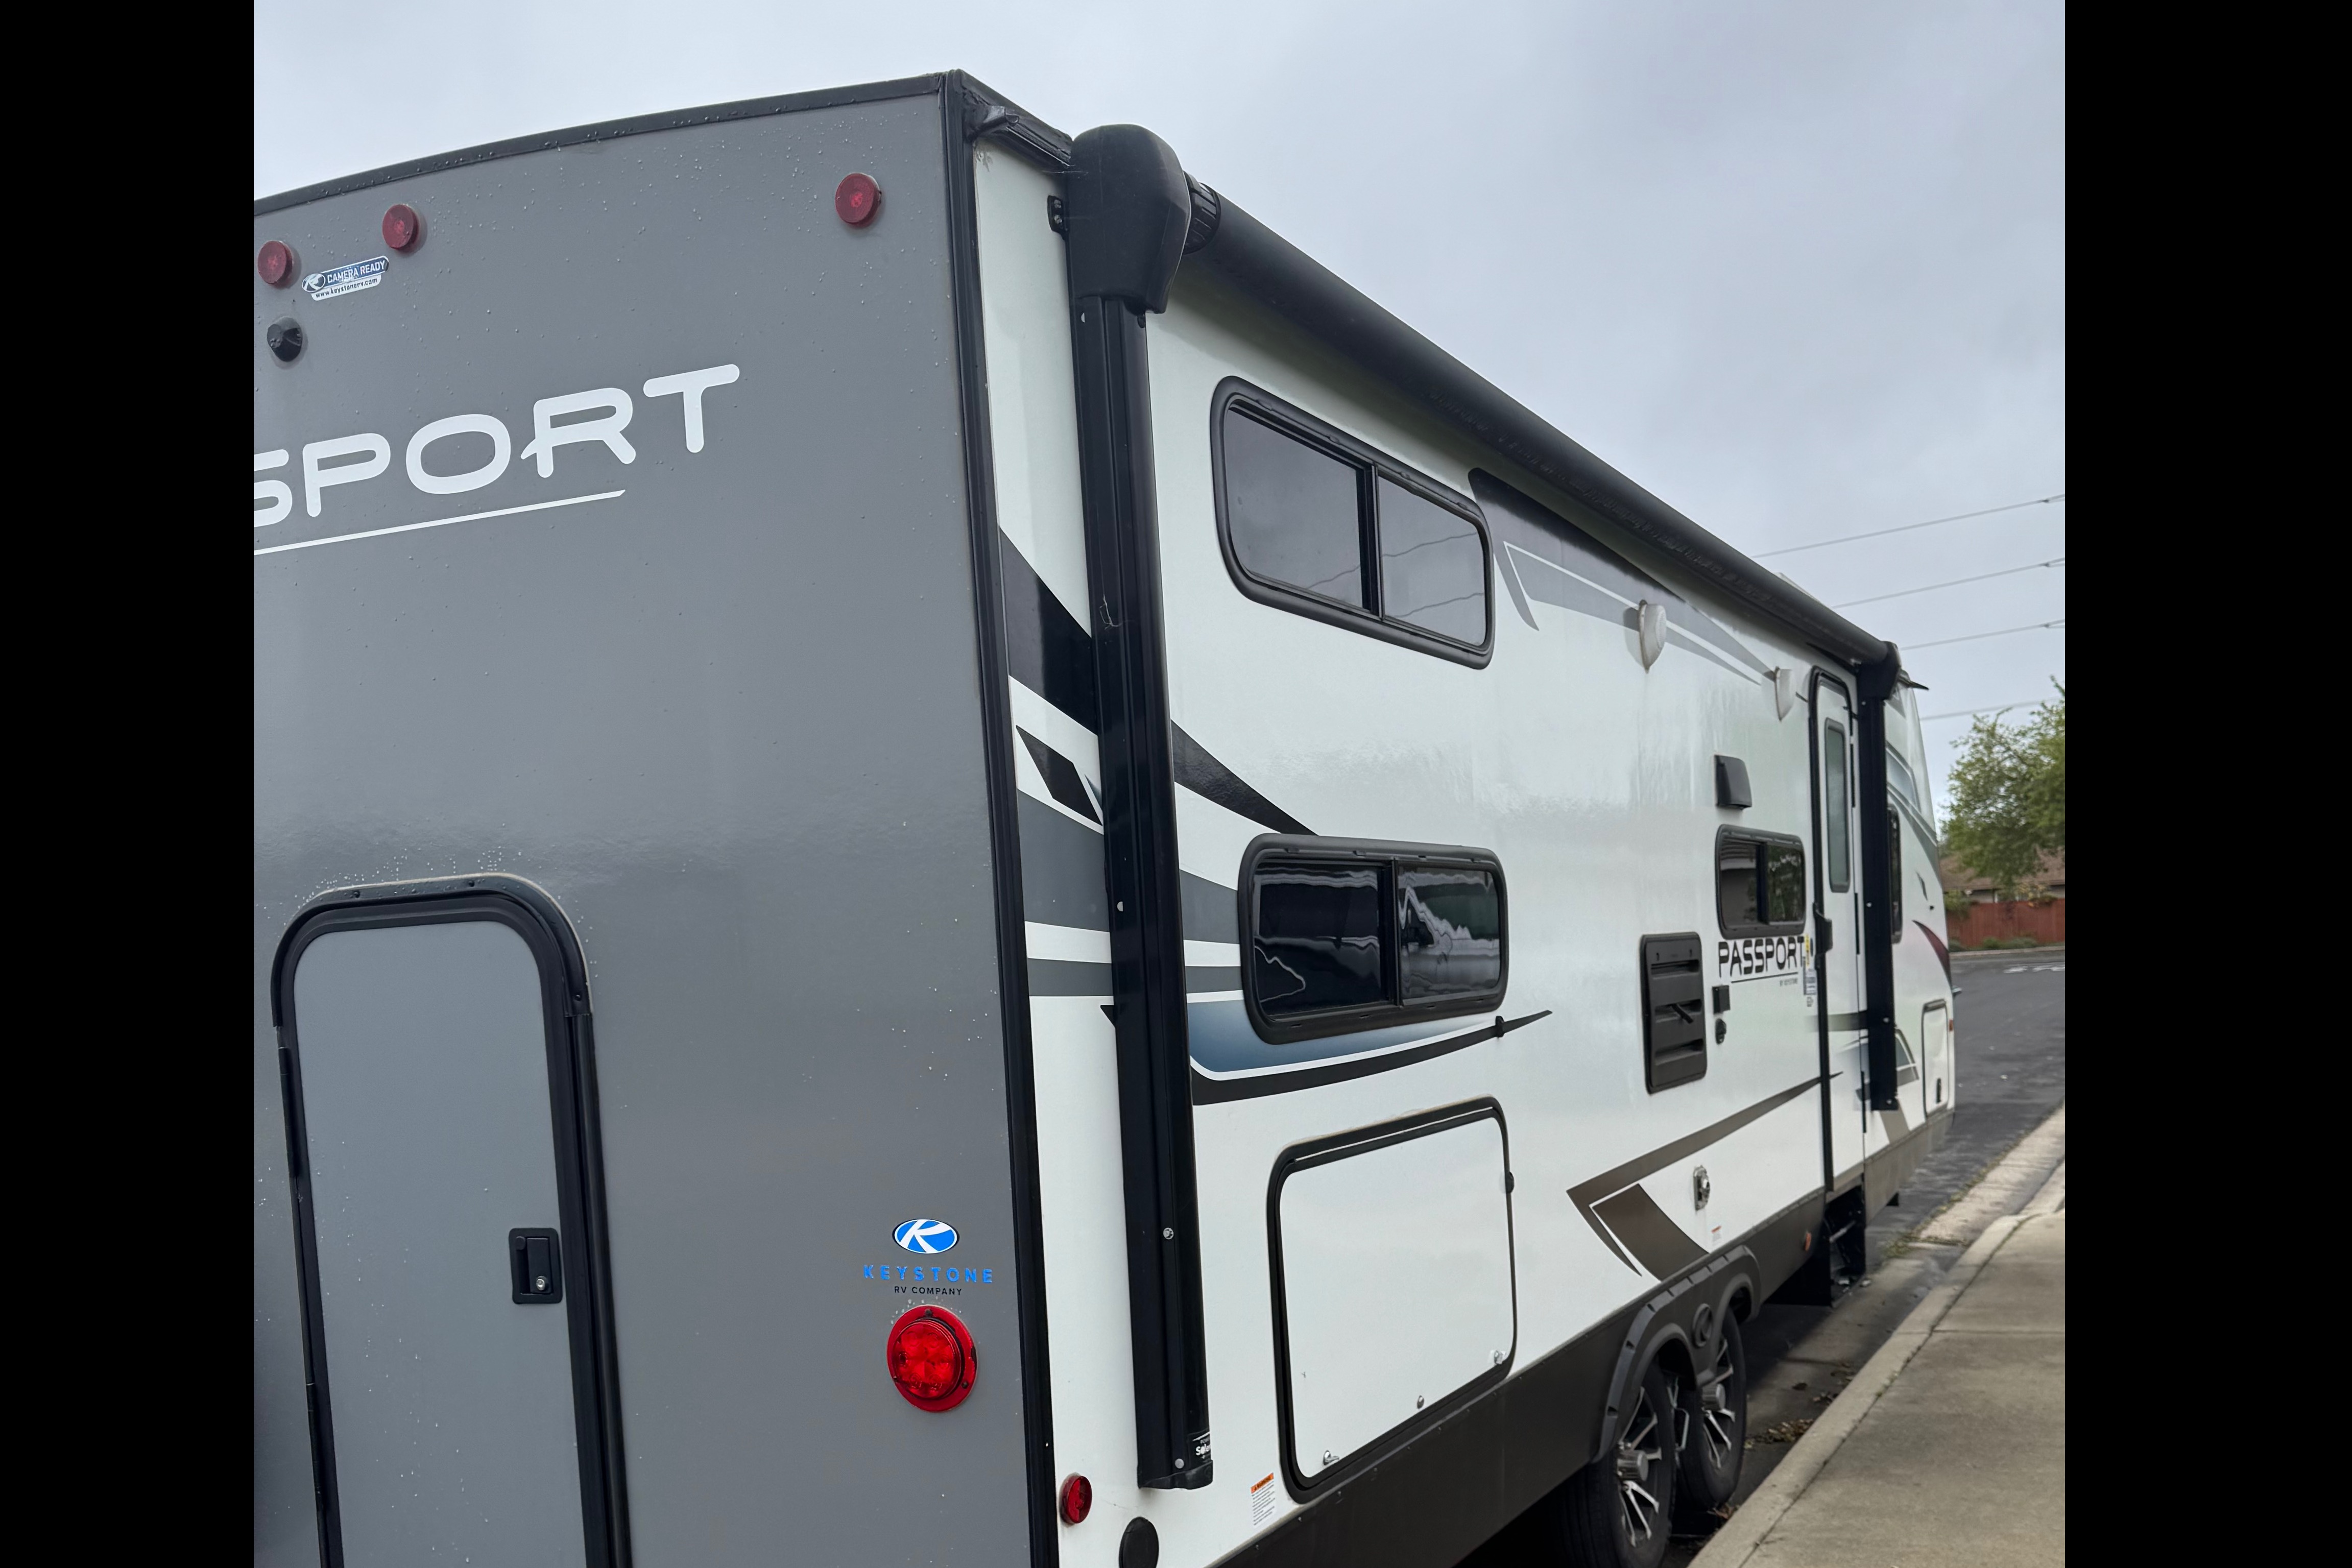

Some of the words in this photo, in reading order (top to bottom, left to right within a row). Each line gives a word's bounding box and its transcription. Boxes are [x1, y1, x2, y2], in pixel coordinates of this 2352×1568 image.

[327, 268, 359, 283] CAMERA
[359, 260, 386, 275] READY
[1718, 935, 1805, 978] PASSPORT
[863, 1265, 993, 1284] KEYSTONE
[911, 1286, 962, 1295] COMPANY
